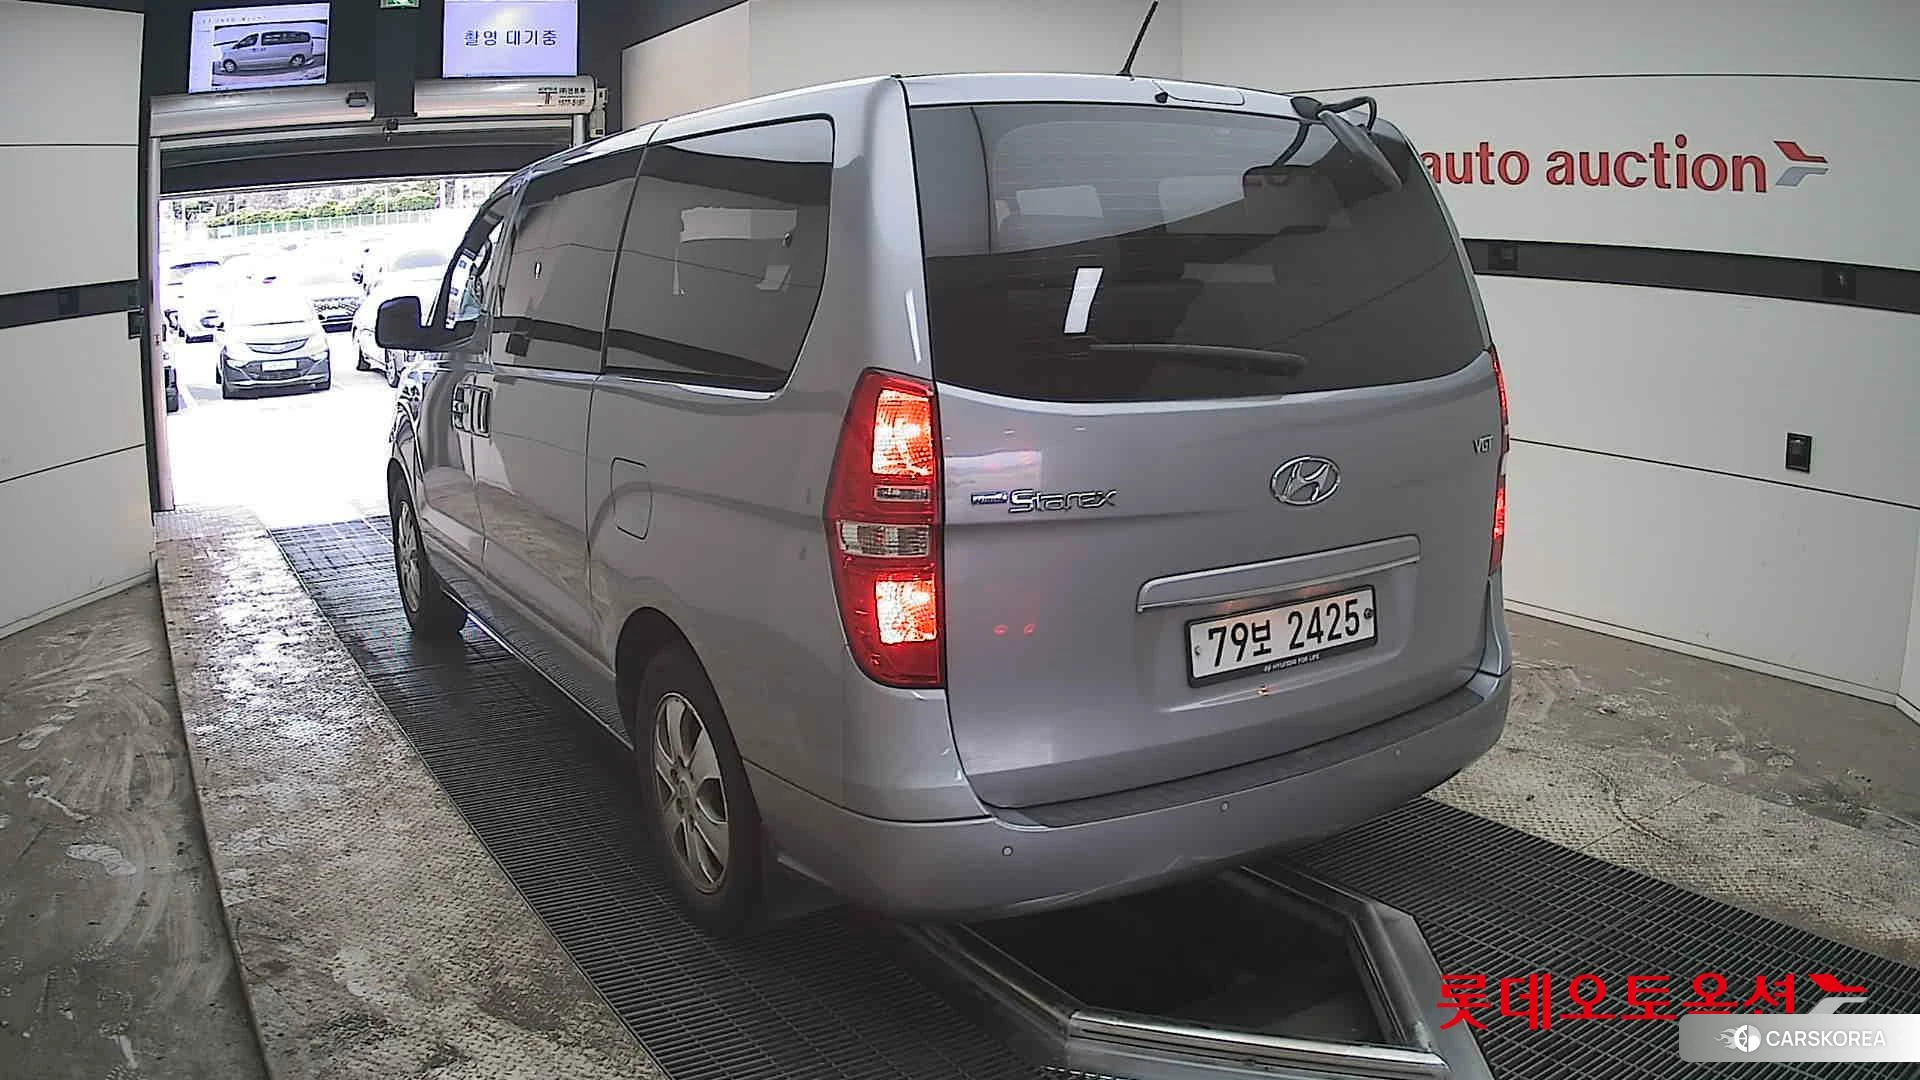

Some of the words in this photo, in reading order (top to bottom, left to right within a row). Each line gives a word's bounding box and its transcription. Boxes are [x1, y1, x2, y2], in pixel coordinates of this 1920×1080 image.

[464, 29, 497, 47] 촬영
[505, 29, 558, 46] 대기중
[1418, 141, 1530, 185] auto
[1545, 134, 1767, 193] auction
[1472, 434, 1495, 454] VGT
[1008, 488, 1118, 513] Starex
[1207, 618, 1272, 668] 79보
[1287, 599, 1360, 651] 2425
